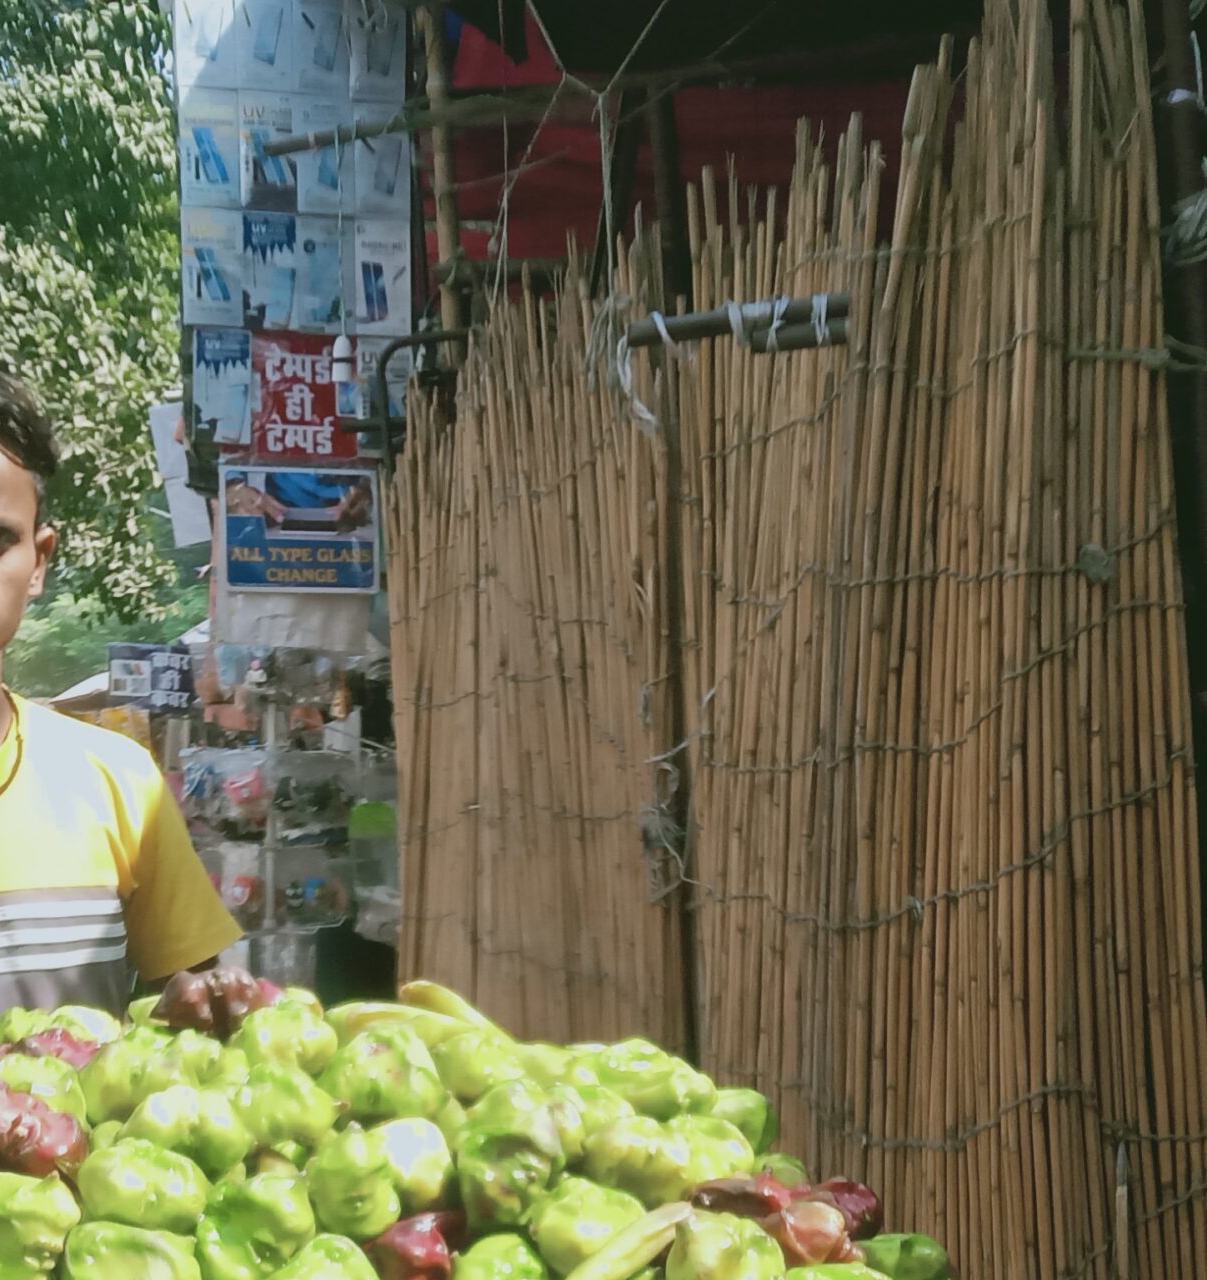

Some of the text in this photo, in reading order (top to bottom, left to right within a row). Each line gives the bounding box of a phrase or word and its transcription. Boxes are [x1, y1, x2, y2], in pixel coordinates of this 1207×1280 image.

[284, 384, 315, 421] ही
[231, 546, 372, 563] ALL TYPE GLASS
[265, 567, 338, 583] CHANGE
